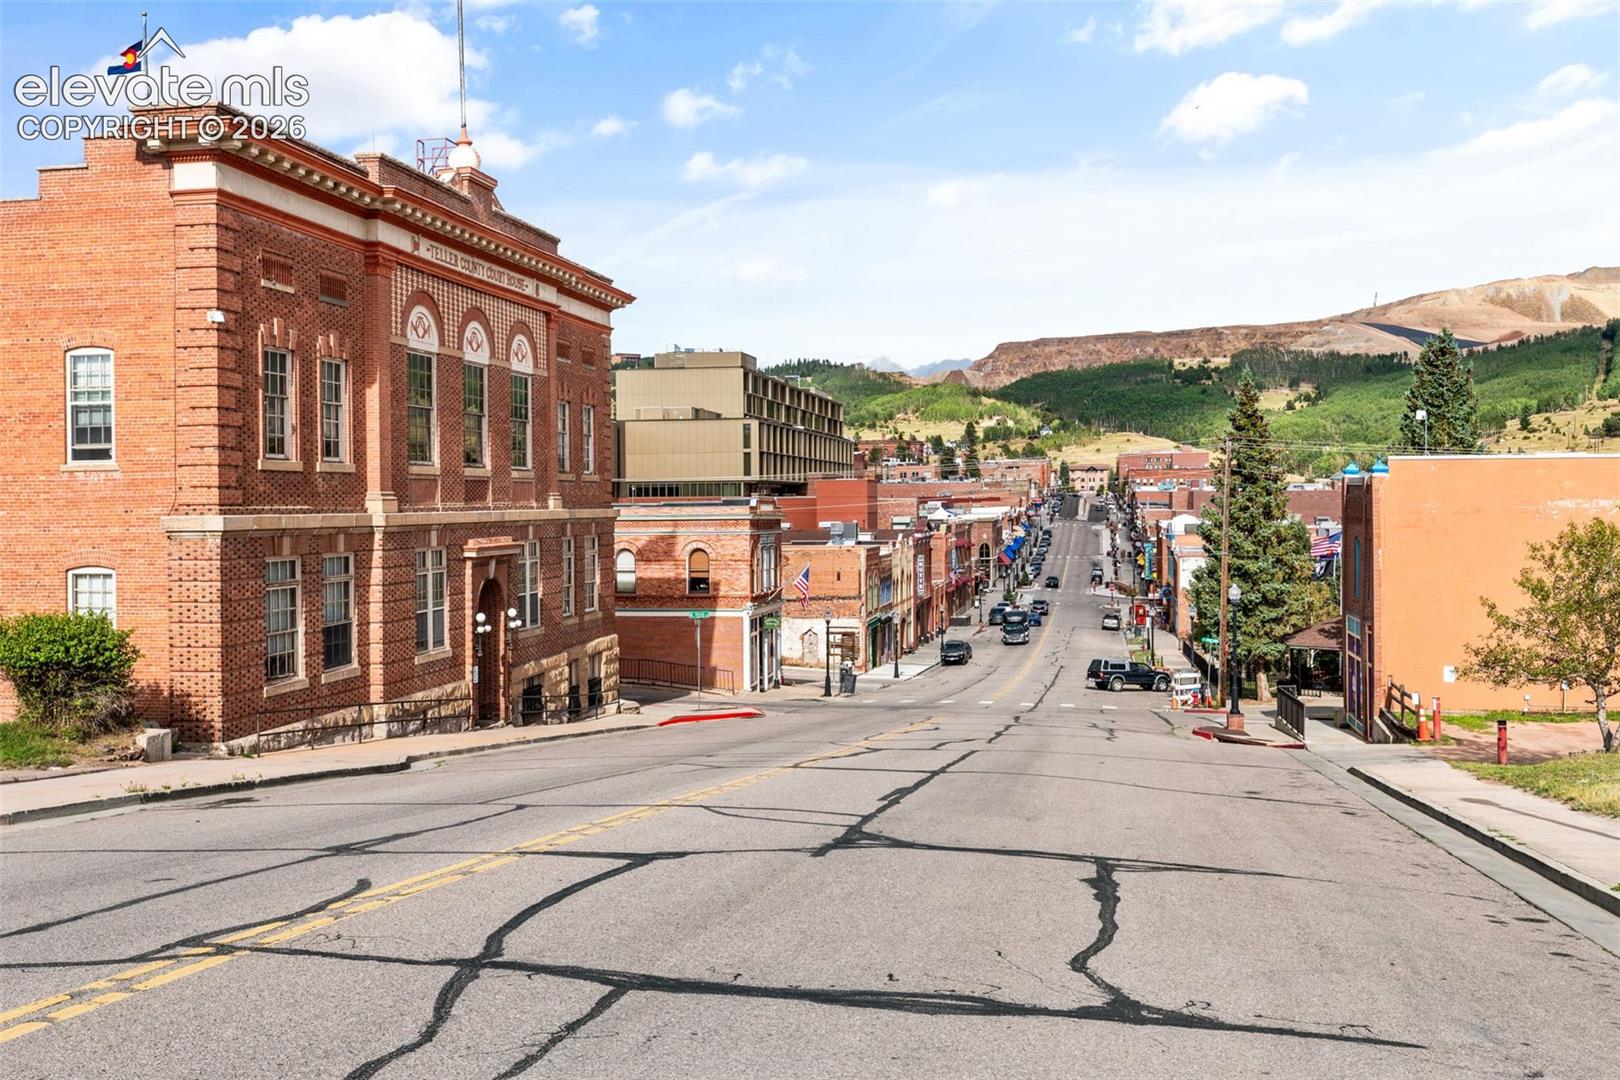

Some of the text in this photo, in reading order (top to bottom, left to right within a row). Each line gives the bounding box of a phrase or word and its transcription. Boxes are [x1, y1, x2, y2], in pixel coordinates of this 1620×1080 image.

[429, 244, 526, 291] TELLER COUNTY COURT HOUSE
